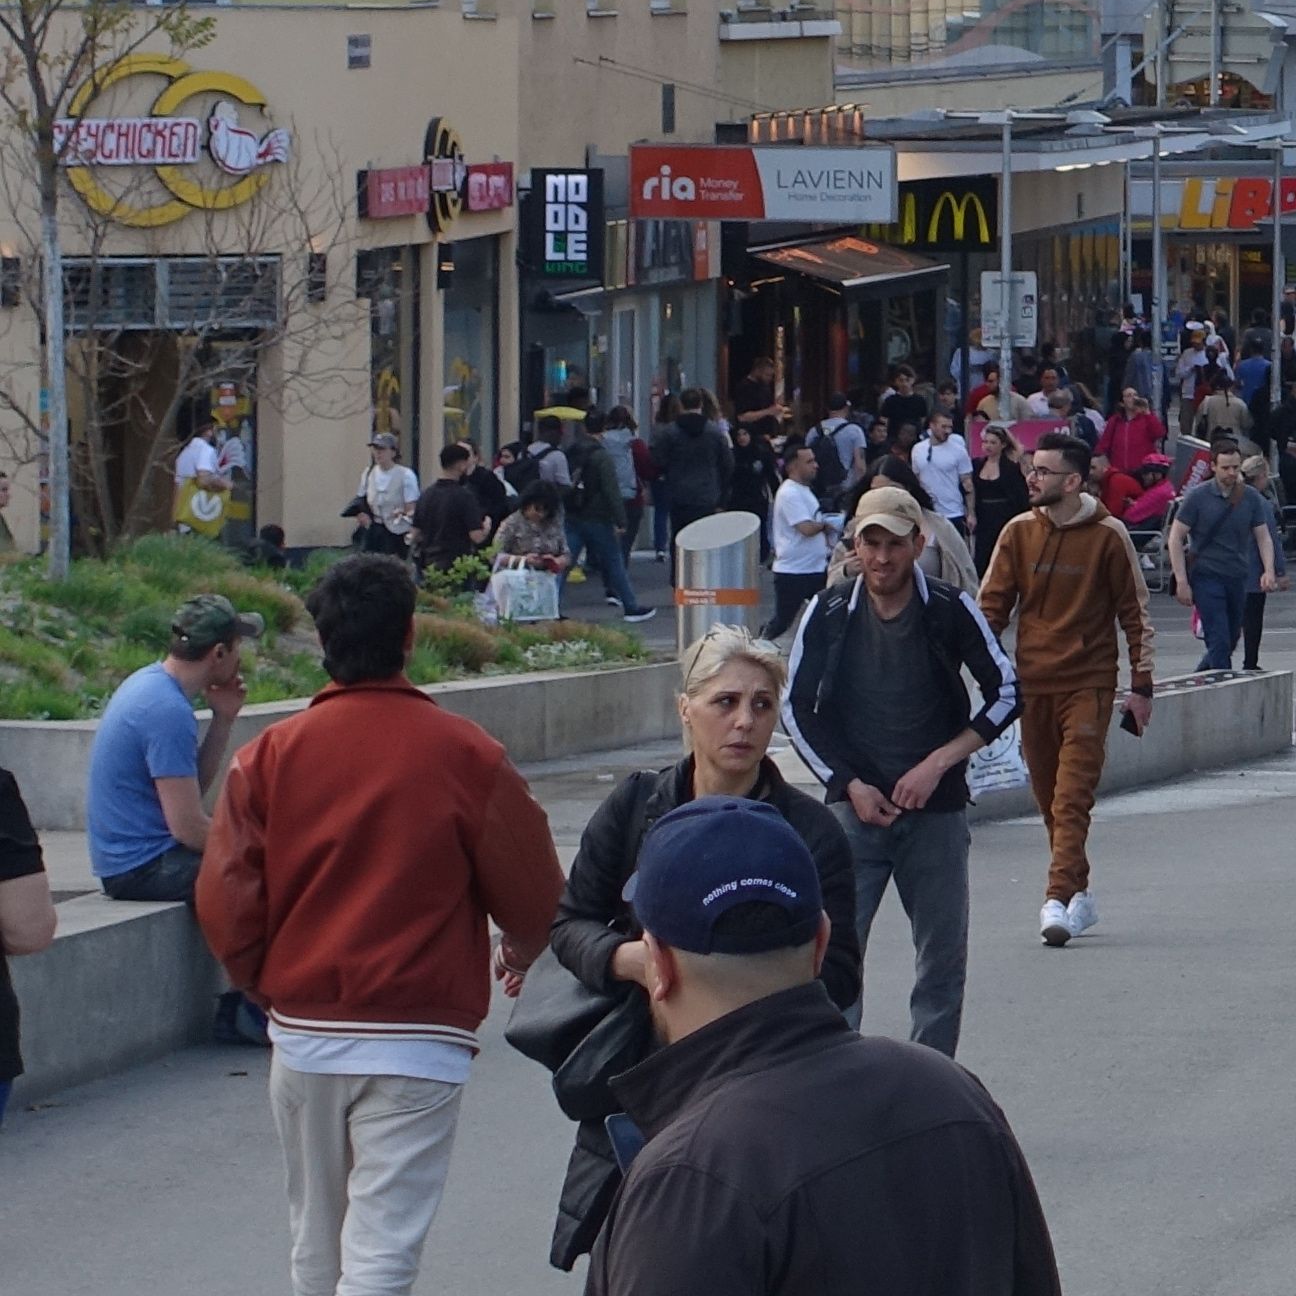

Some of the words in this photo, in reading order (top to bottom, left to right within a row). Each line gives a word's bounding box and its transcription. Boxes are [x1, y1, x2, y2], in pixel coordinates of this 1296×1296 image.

[642, 165, 696, 201] ria
[700, 177, 738, 189] Money
[776, 169, 884, 190] LAVIENN
[700, 191, 745, 202] Transfer
[788, 191, 817, 202] Home
[820, 191, 872, 203] Decoration
[702, 880, 738, 907] nothing
[740, 877, 774, 887] comes
[774, 882, 797, 899] close
